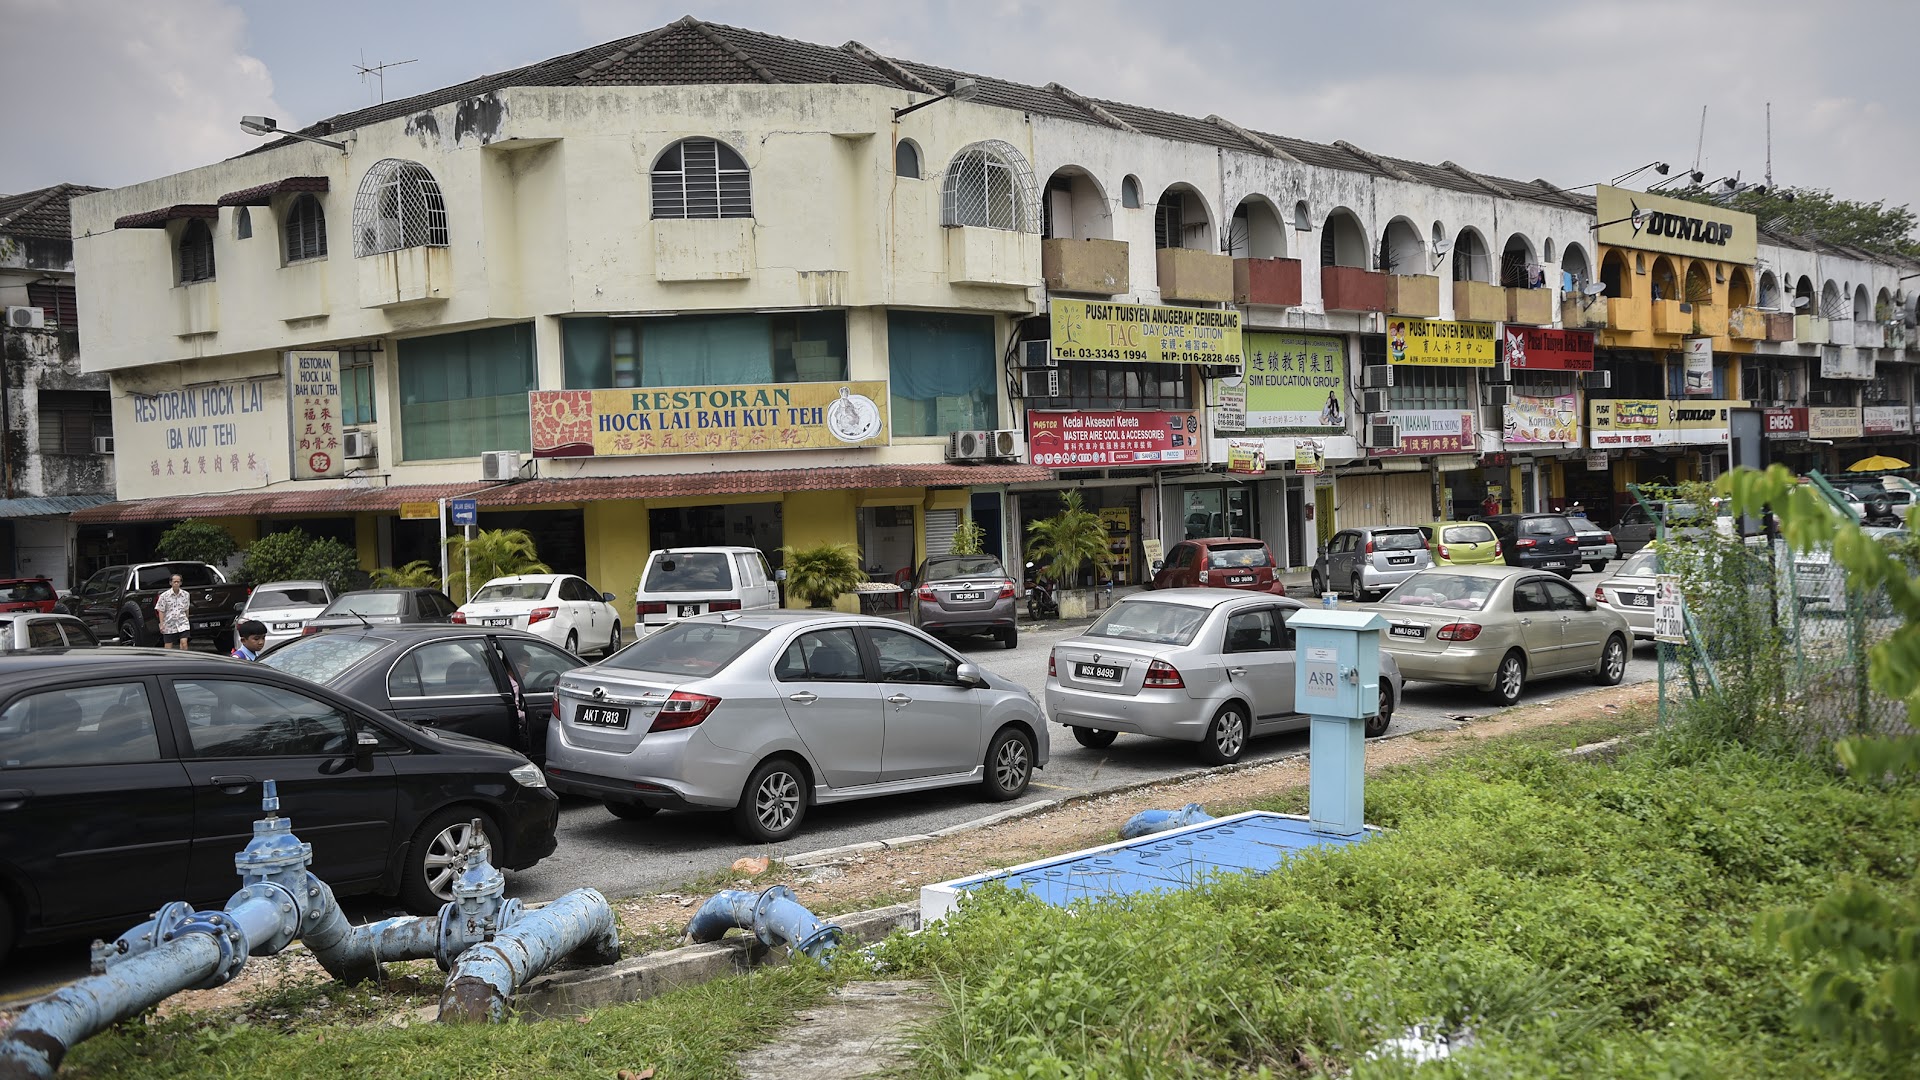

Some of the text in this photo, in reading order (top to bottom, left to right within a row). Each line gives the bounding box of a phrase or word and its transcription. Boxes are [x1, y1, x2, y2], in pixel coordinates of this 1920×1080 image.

[1647, 210, 1733, 246] DUNLOP
[1085, 304, 1238, 328] PUSAT TUISYEN ANUGERAH CEMERLANG
[1107, 323, 1138, 347] TAC
[1143, 324, 1223, 339] DAY CARE TUITION
[1409, 322, 1494, 340] PUSAT TUISYEN BINA INSAN
[1527, 331, 1543, 350] Pusat
[1055, 348, 1147, 360] Tel: 03-3343 1994
[1161, 351, 1240, 363] H/P: 016-2828 465
[300, 357, 331, 369] RESTORAN
[1252, 351, 1334, 373] 连锁教育集团
[300, 371, 331, 382] HOCK LAI
[1249, 374, 1340, 387] SIM EDUCATION GROUP
[296, 384, 338, 395] BAH KUT TEH
[134, 383, 263, 423] RESTORAN HOCK LAI
[631, 388, 791, 411] RESTORAN
[1596, 405, 1610, 414] PUSAT
[1675, 409, 1716, 421] DUNLOP
[599, 407, 823, 432] HOCK LAI BAH KUT TEH
[1033, 421, 1058, 429] MASTER
[1062, 415, 1139, 428] Kedai Aksesori Kereta
[1405, 415, 1431, 431] MAKANAN
[1431, 420, 1444, 431] TECK
[1444, 420, 1460, 431] SEONG
[1597, 417, 1610, 426] TAYAR
[1769, 415, 1794, 430] ENEOS
[166, 423, 237, 449] (BA KUT TEH)
[1063, 430, 1165, 440] MASTER AIRE COOL & ACCESSORIES
[299, 437, 339, 450] 肉骨茶
[1663, 606, 1674, 618] 013
[1394, 627, 1407, 635] WMU
[1656, 618, 1667, 635] 327
[1082, 665, 1115, 678] WSX 8499
[583, 709, 620, 723] AKT 7813
